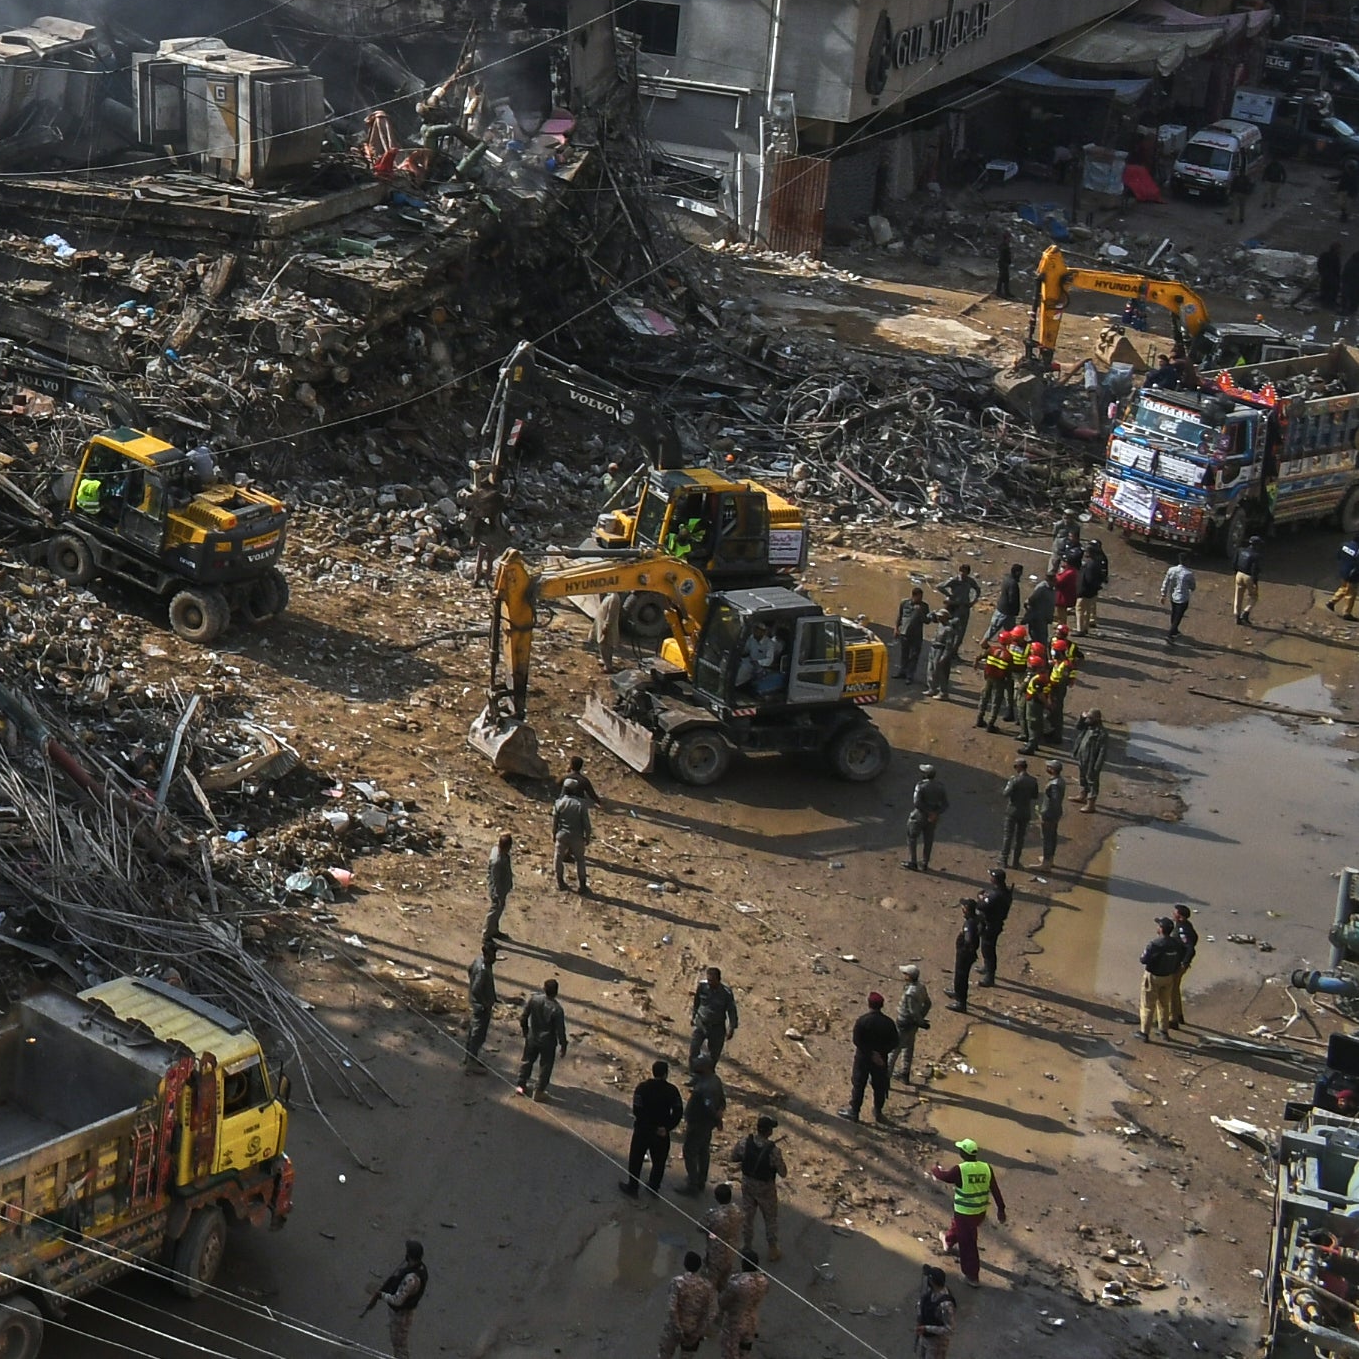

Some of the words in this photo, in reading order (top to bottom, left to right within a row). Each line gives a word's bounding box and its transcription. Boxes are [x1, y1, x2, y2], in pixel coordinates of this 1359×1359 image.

[15, 373, 59, 392] VOLVO
[569, 389, 615, 415] VOLVO
[247, 548, 275, 562] VOLVO
[565, 576, 620, 592] HYUNDAI
